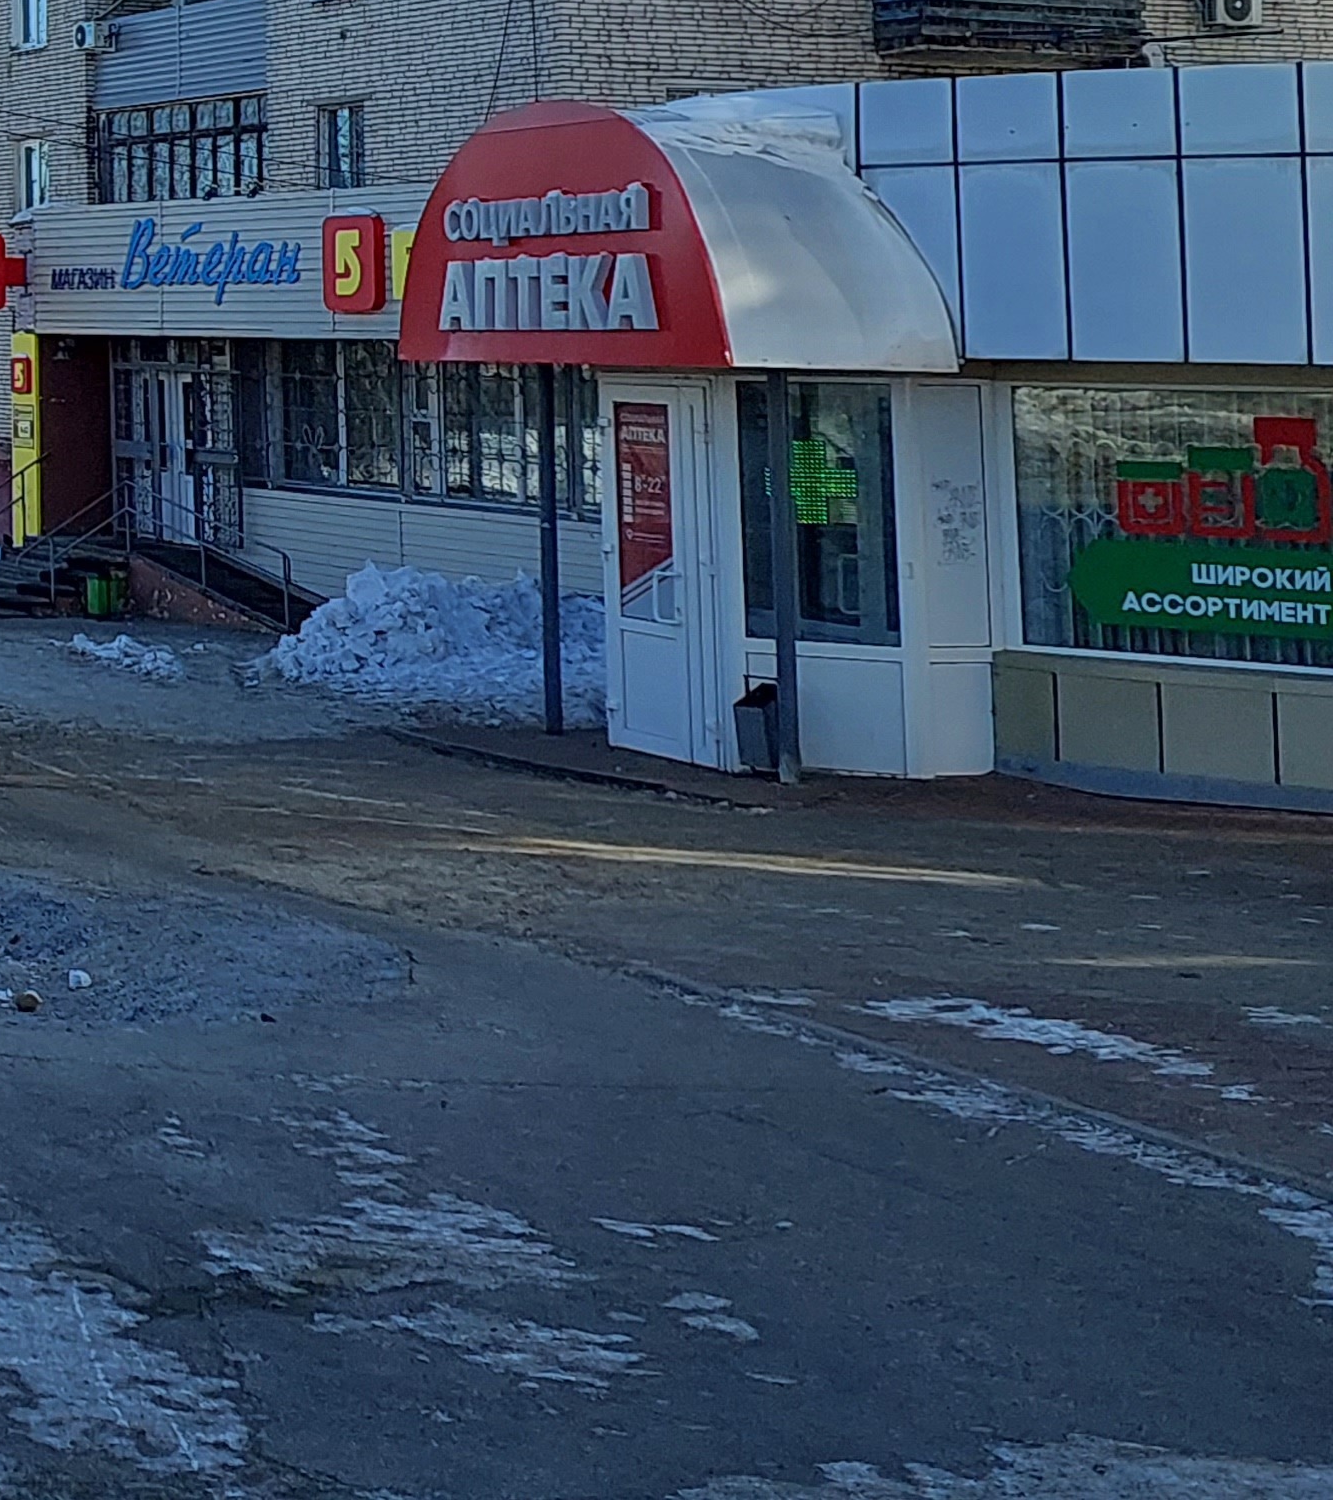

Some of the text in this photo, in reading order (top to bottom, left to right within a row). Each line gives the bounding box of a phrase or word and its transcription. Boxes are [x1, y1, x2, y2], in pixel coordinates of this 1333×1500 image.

[443, 182, 651, 246] СОЦИАЛЬНАЯ
[51, 218, 301, 305] МАГАЗИН Ветеран
[335, 228, 361, 297] 5
[437, 251, 660, 331] АПТЕКА
[620, 425, 666, 443] АПТЕКА
[1121, 590, 1332, 625] АССОРТИМЕНТ
[1191, 562, 1332, 592] ШИРОКИЙ
